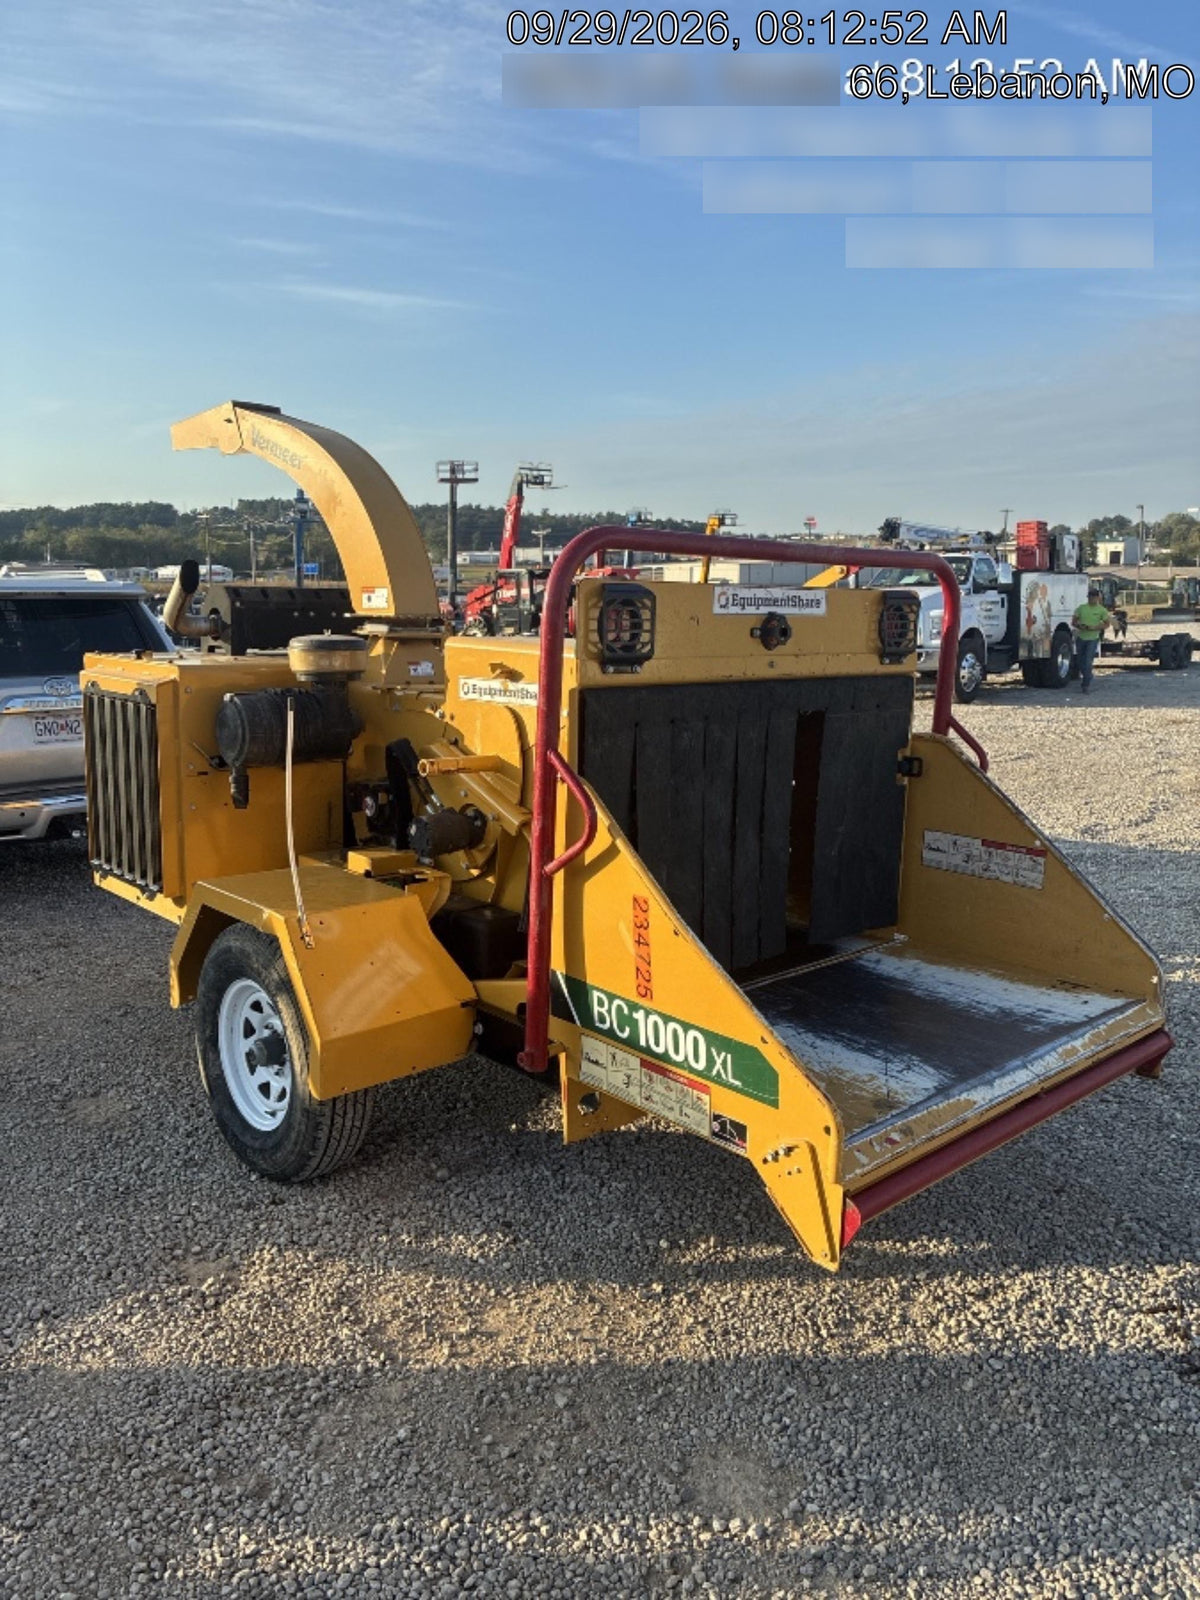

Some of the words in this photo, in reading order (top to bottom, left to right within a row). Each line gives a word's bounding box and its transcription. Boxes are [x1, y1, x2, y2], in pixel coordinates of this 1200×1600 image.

[251, 424, 304, 470] Vermeer
[731, 592, 823, 611] EquipmentShare
[471, 683, 538, 700] EquipmentSha
[632, 895, 653, 1001] 234725
